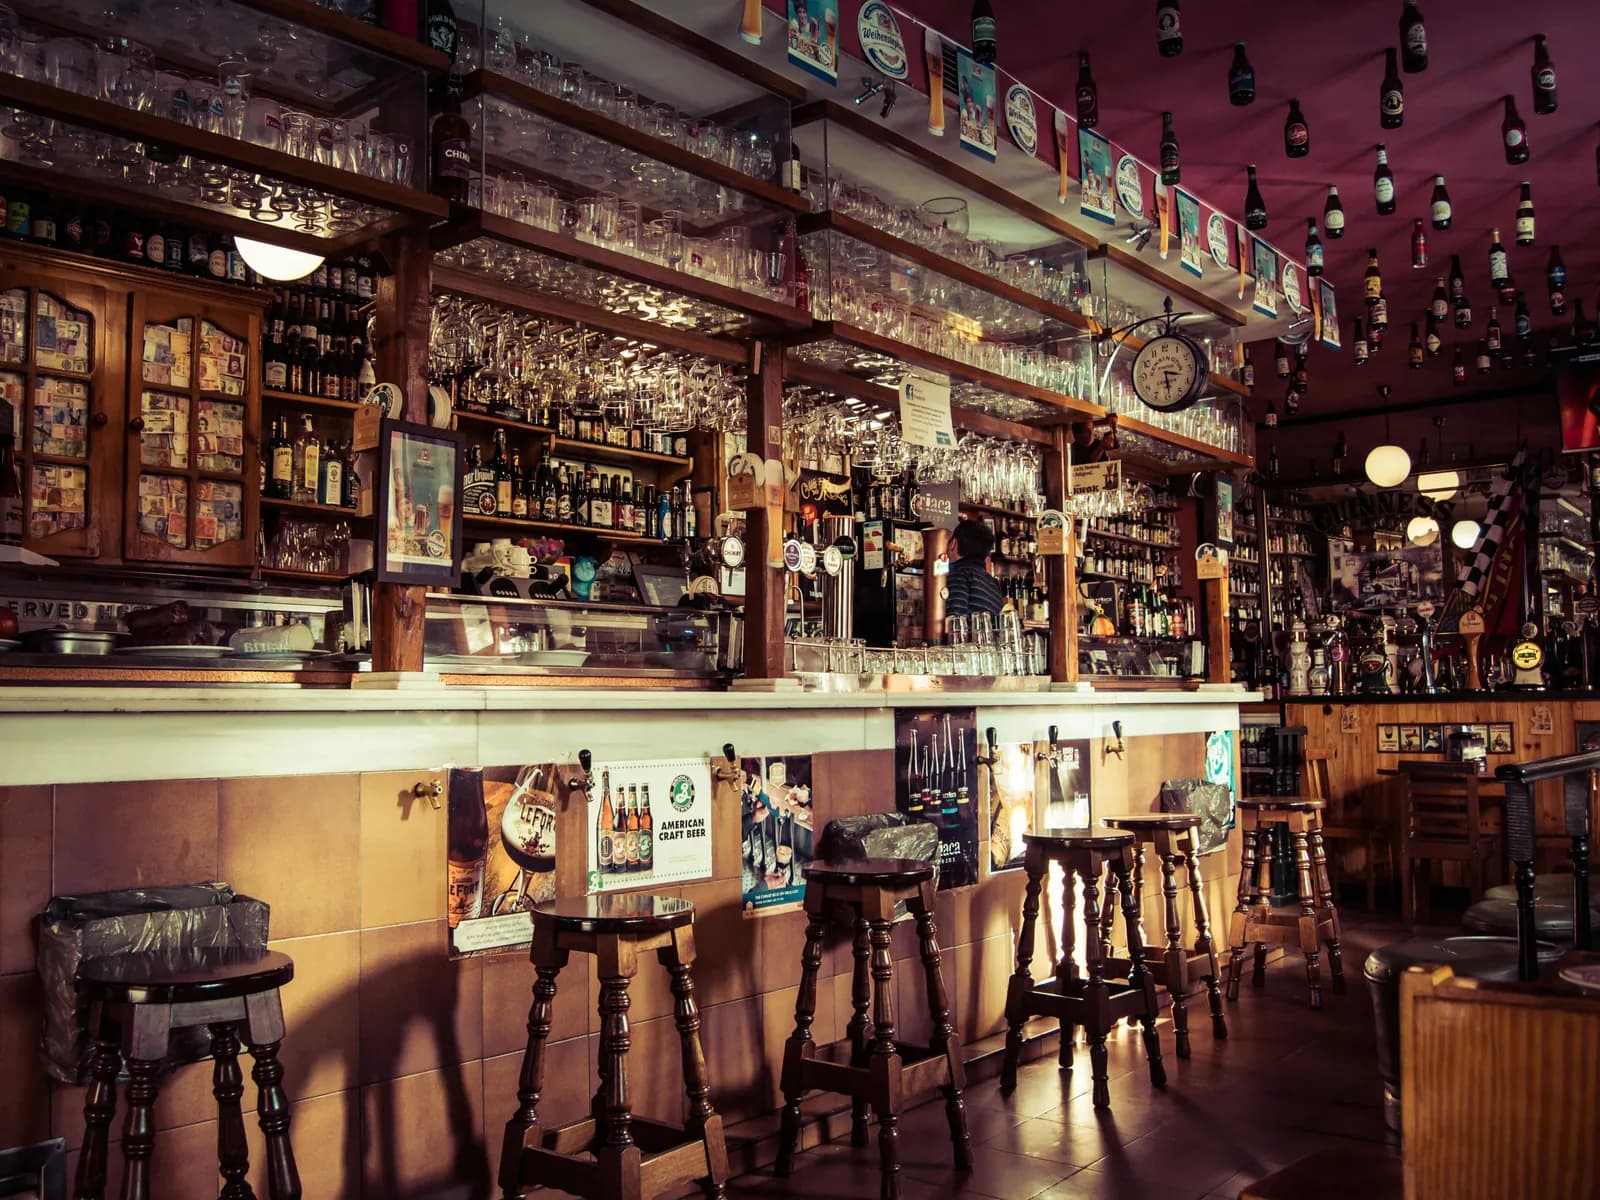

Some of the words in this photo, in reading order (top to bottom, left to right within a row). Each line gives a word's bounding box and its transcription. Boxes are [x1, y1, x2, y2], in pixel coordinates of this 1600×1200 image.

[1313, 492, 1455, 532] GUINNESS
[661, 818, 705, 831] AMERICAN
[658, 830, 684, 841] CRAFT
[686, 828, 706, 839] BEER
